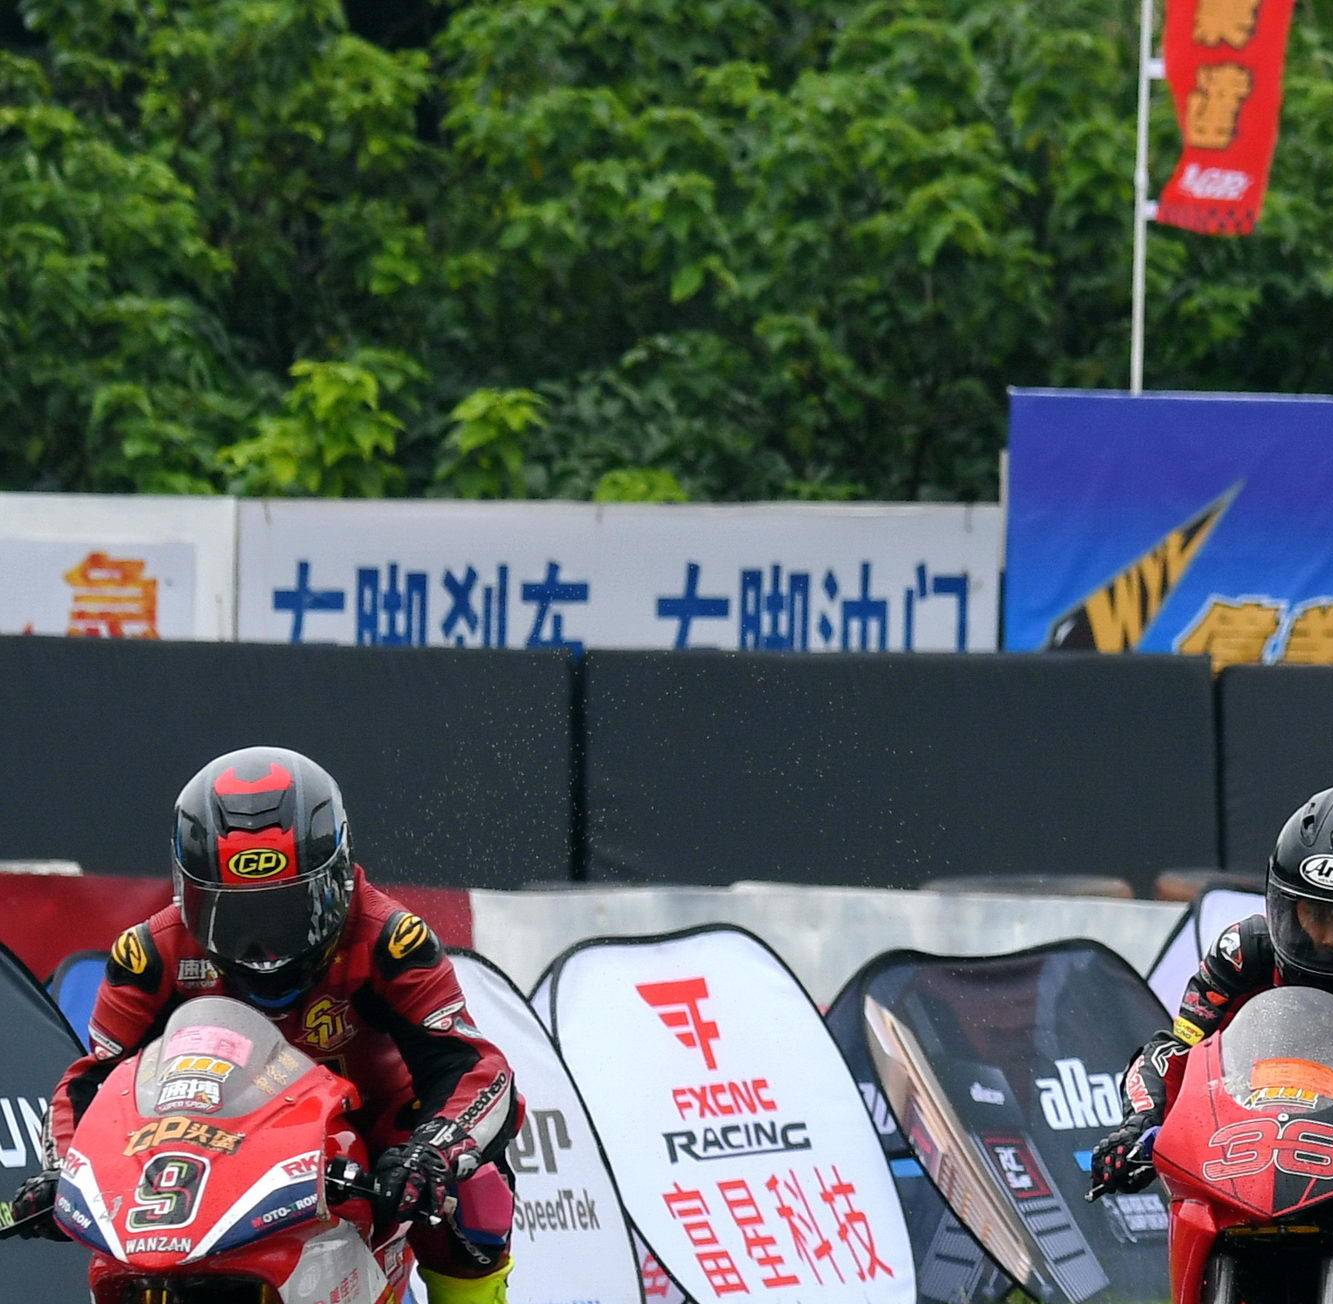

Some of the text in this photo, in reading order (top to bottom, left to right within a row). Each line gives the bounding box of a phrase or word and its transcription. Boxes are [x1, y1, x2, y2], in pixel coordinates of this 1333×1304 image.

[239, 852, 277, 873] GP
[671, 1079, 778, 1121] FXCNC
[662, 1120, 812, 1163] RACING
[126, 1152, 211, 1233] 9
[125, 1237, 192, 1254] WANZAN
[662, 1165, 896, 1299] 富星科技
